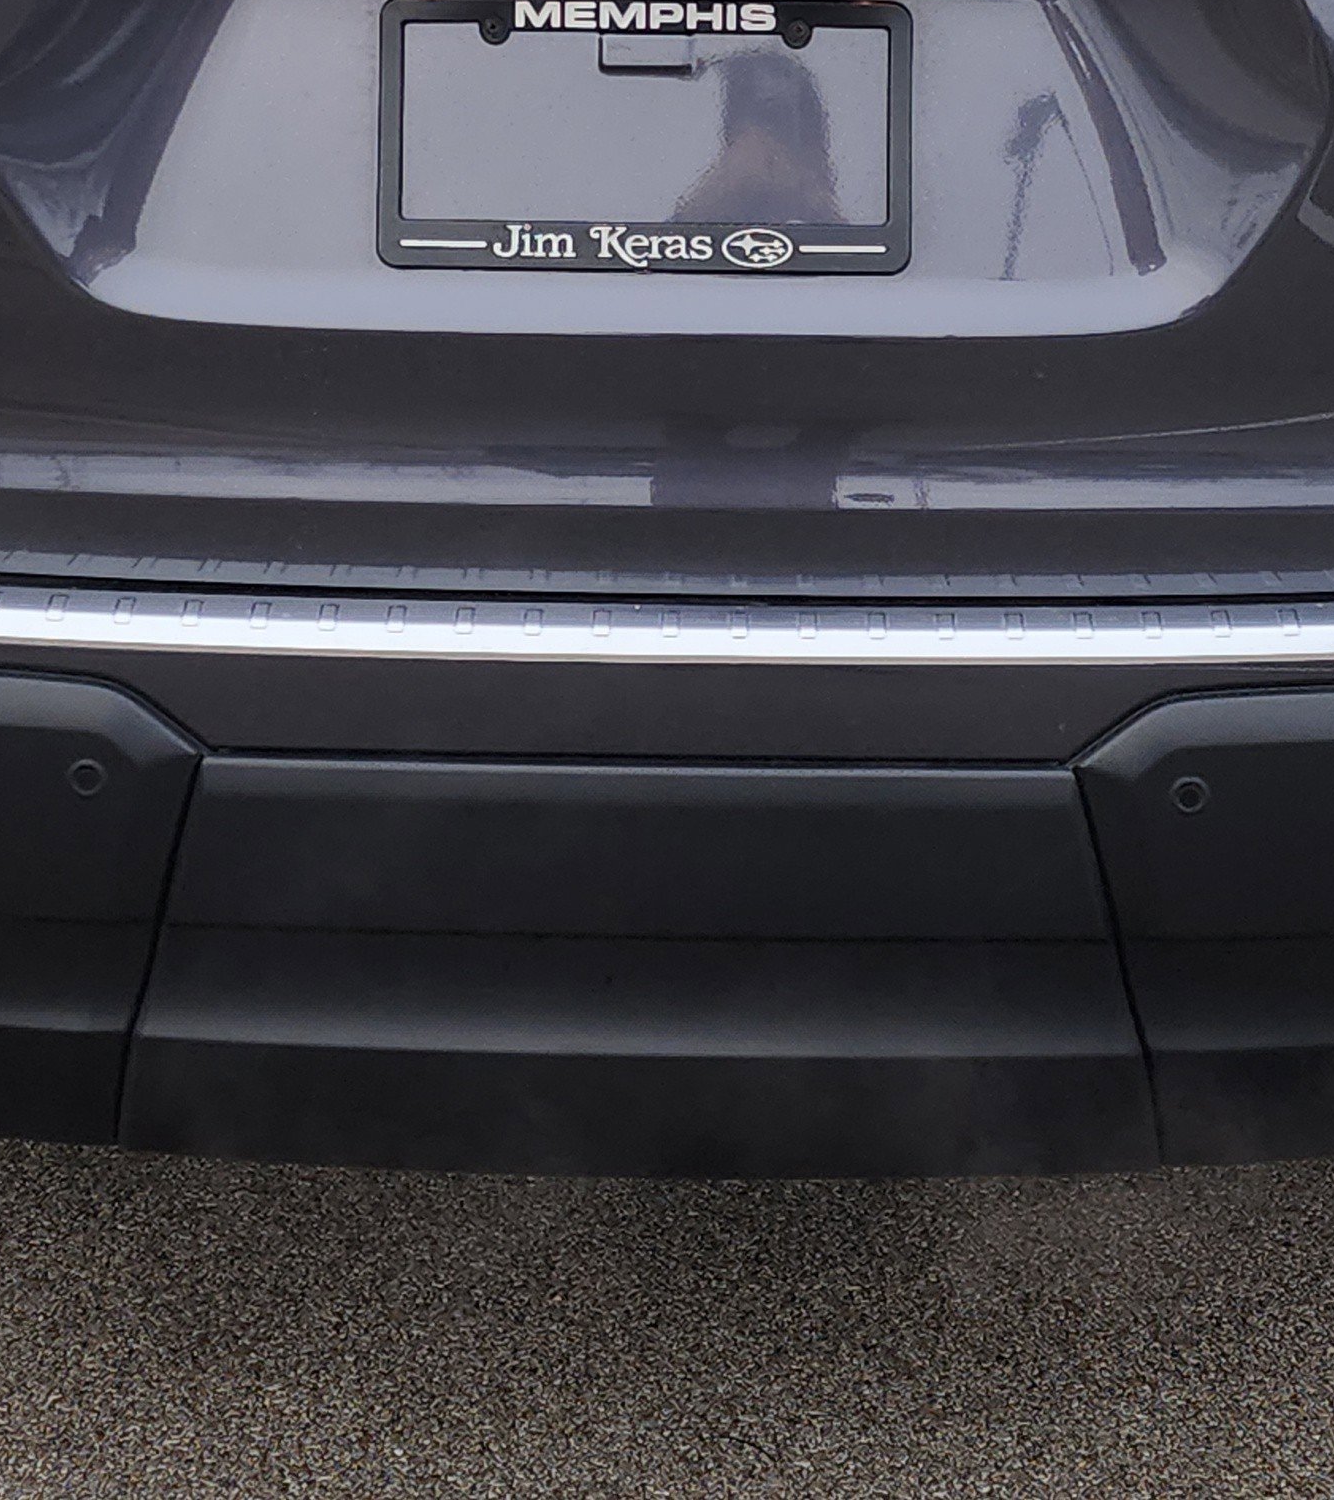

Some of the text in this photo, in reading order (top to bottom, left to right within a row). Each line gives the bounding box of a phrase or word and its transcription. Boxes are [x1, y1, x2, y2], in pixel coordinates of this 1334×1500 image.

[514, 0, 777, 32] MEMPHIS
[492, 223, 713, 268] Jim Keras
